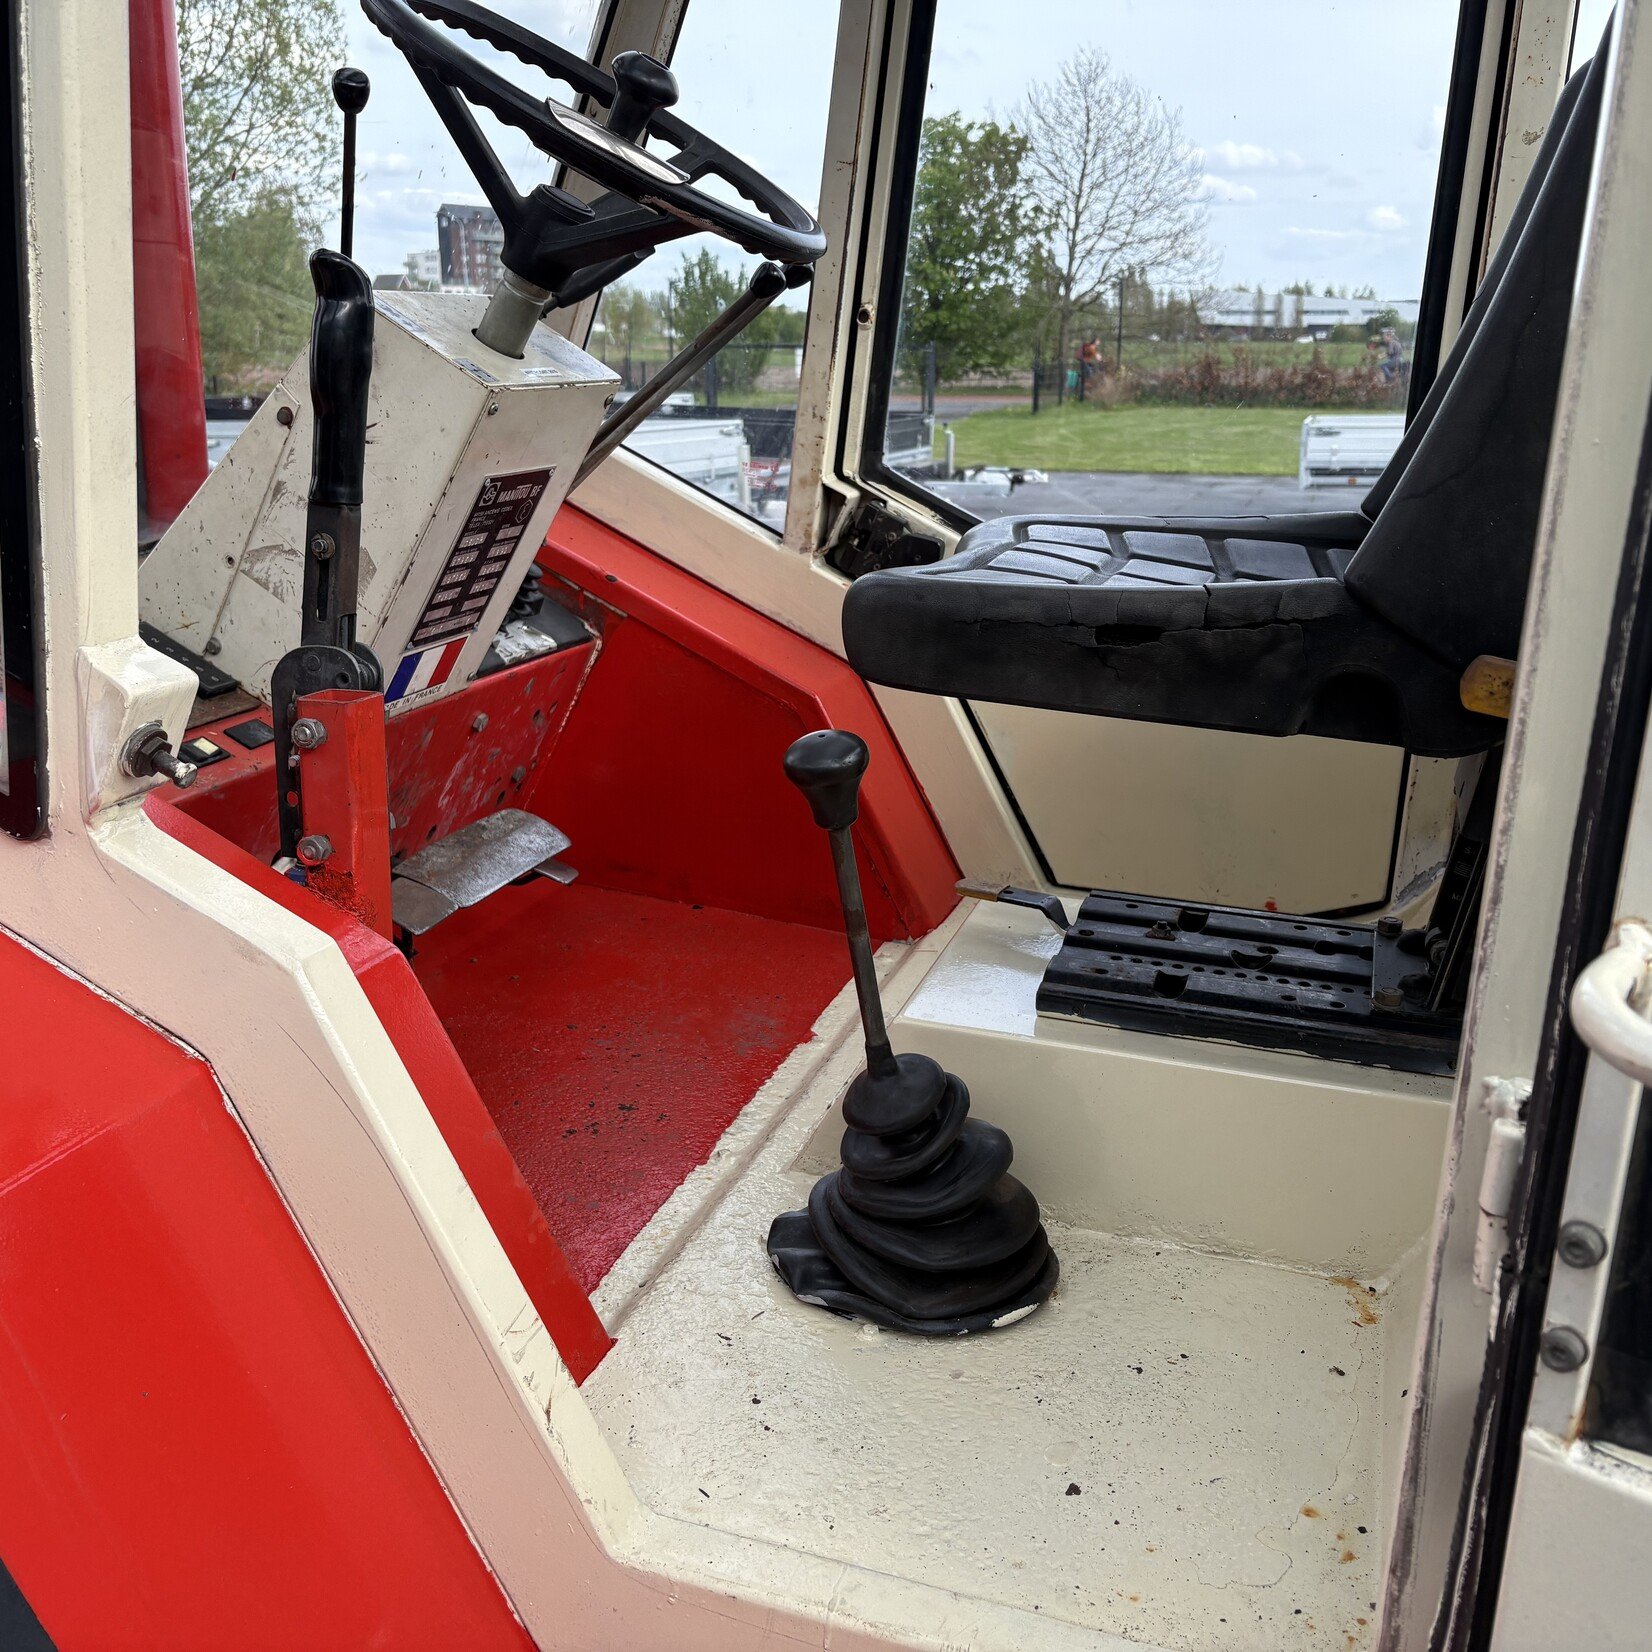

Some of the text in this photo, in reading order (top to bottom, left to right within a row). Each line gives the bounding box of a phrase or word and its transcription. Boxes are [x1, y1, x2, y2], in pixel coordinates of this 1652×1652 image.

[497, 484, 543, 503] MANITOU BF
[402, 697, 412, 705] IN
[413, 685, 443, 702] FRANCE
